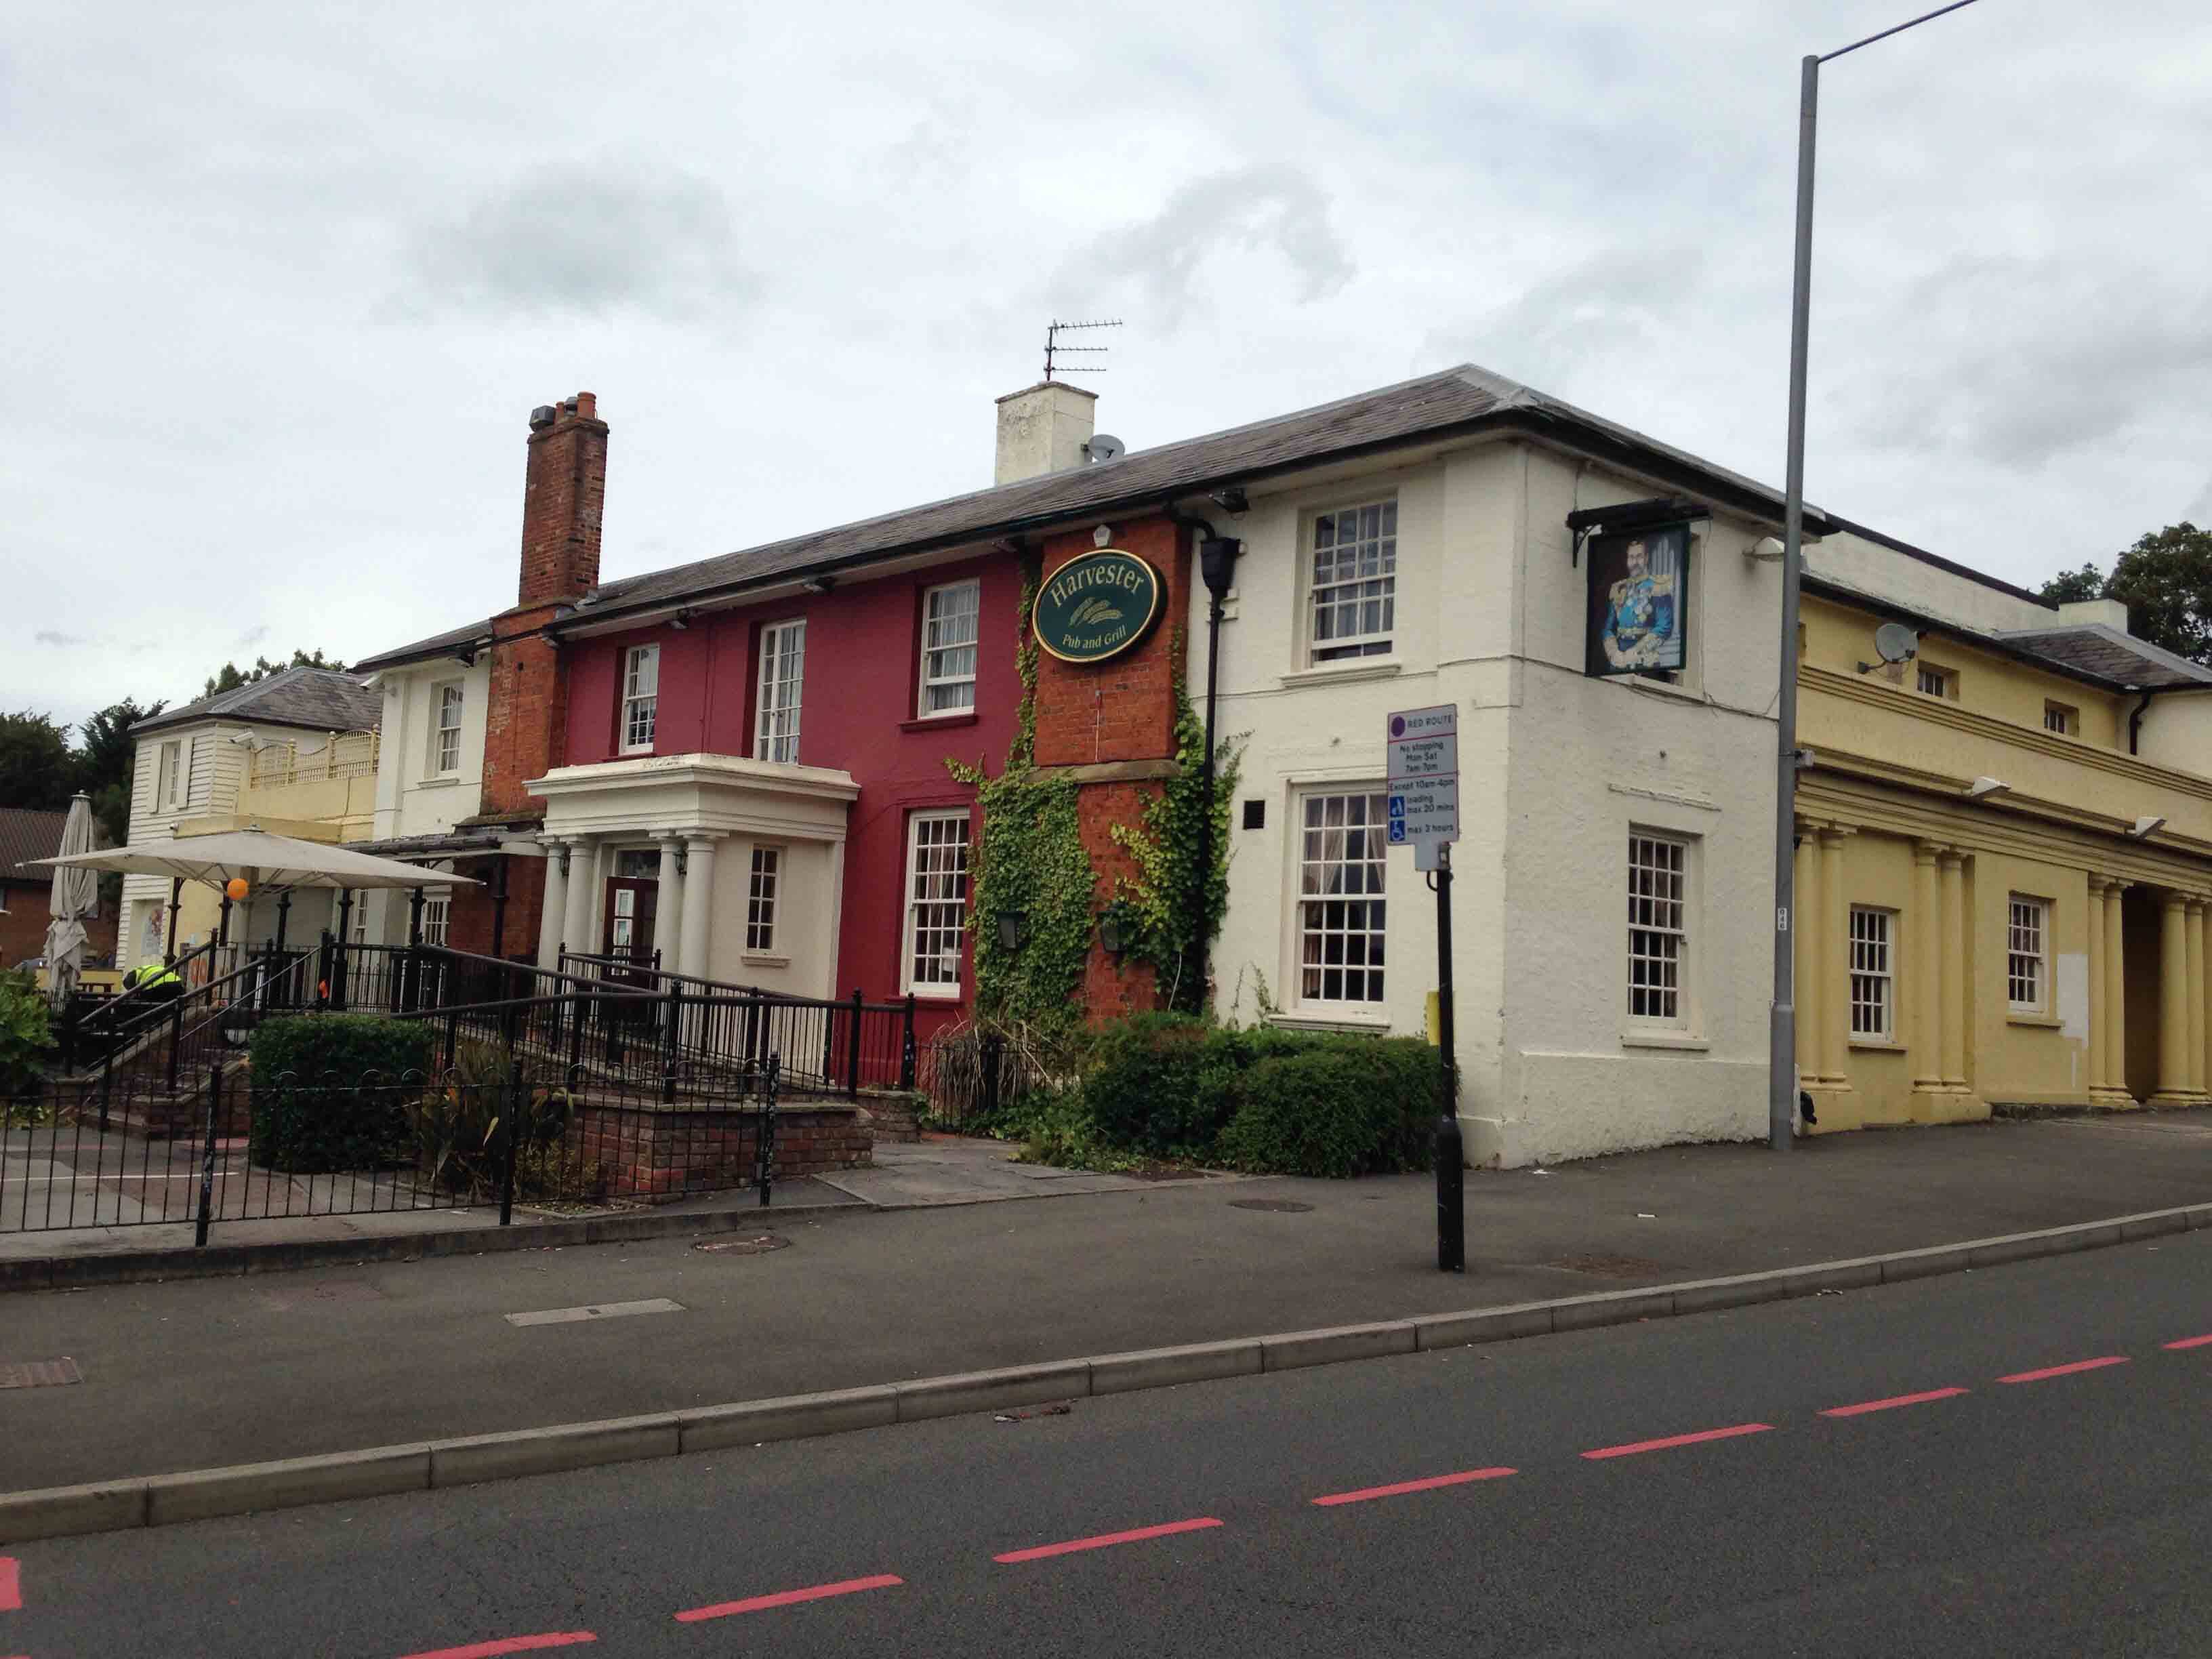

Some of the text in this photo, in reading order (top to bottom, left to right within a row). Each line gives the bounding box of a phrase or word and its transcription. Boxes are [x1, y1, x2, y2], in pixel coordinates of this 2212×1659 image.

[1051, 564, 1144, 607] Harvester
[1063, 625, 1126, 649] Pub and Grill
[1408, 714, 1452, 728] RED ROUTE
